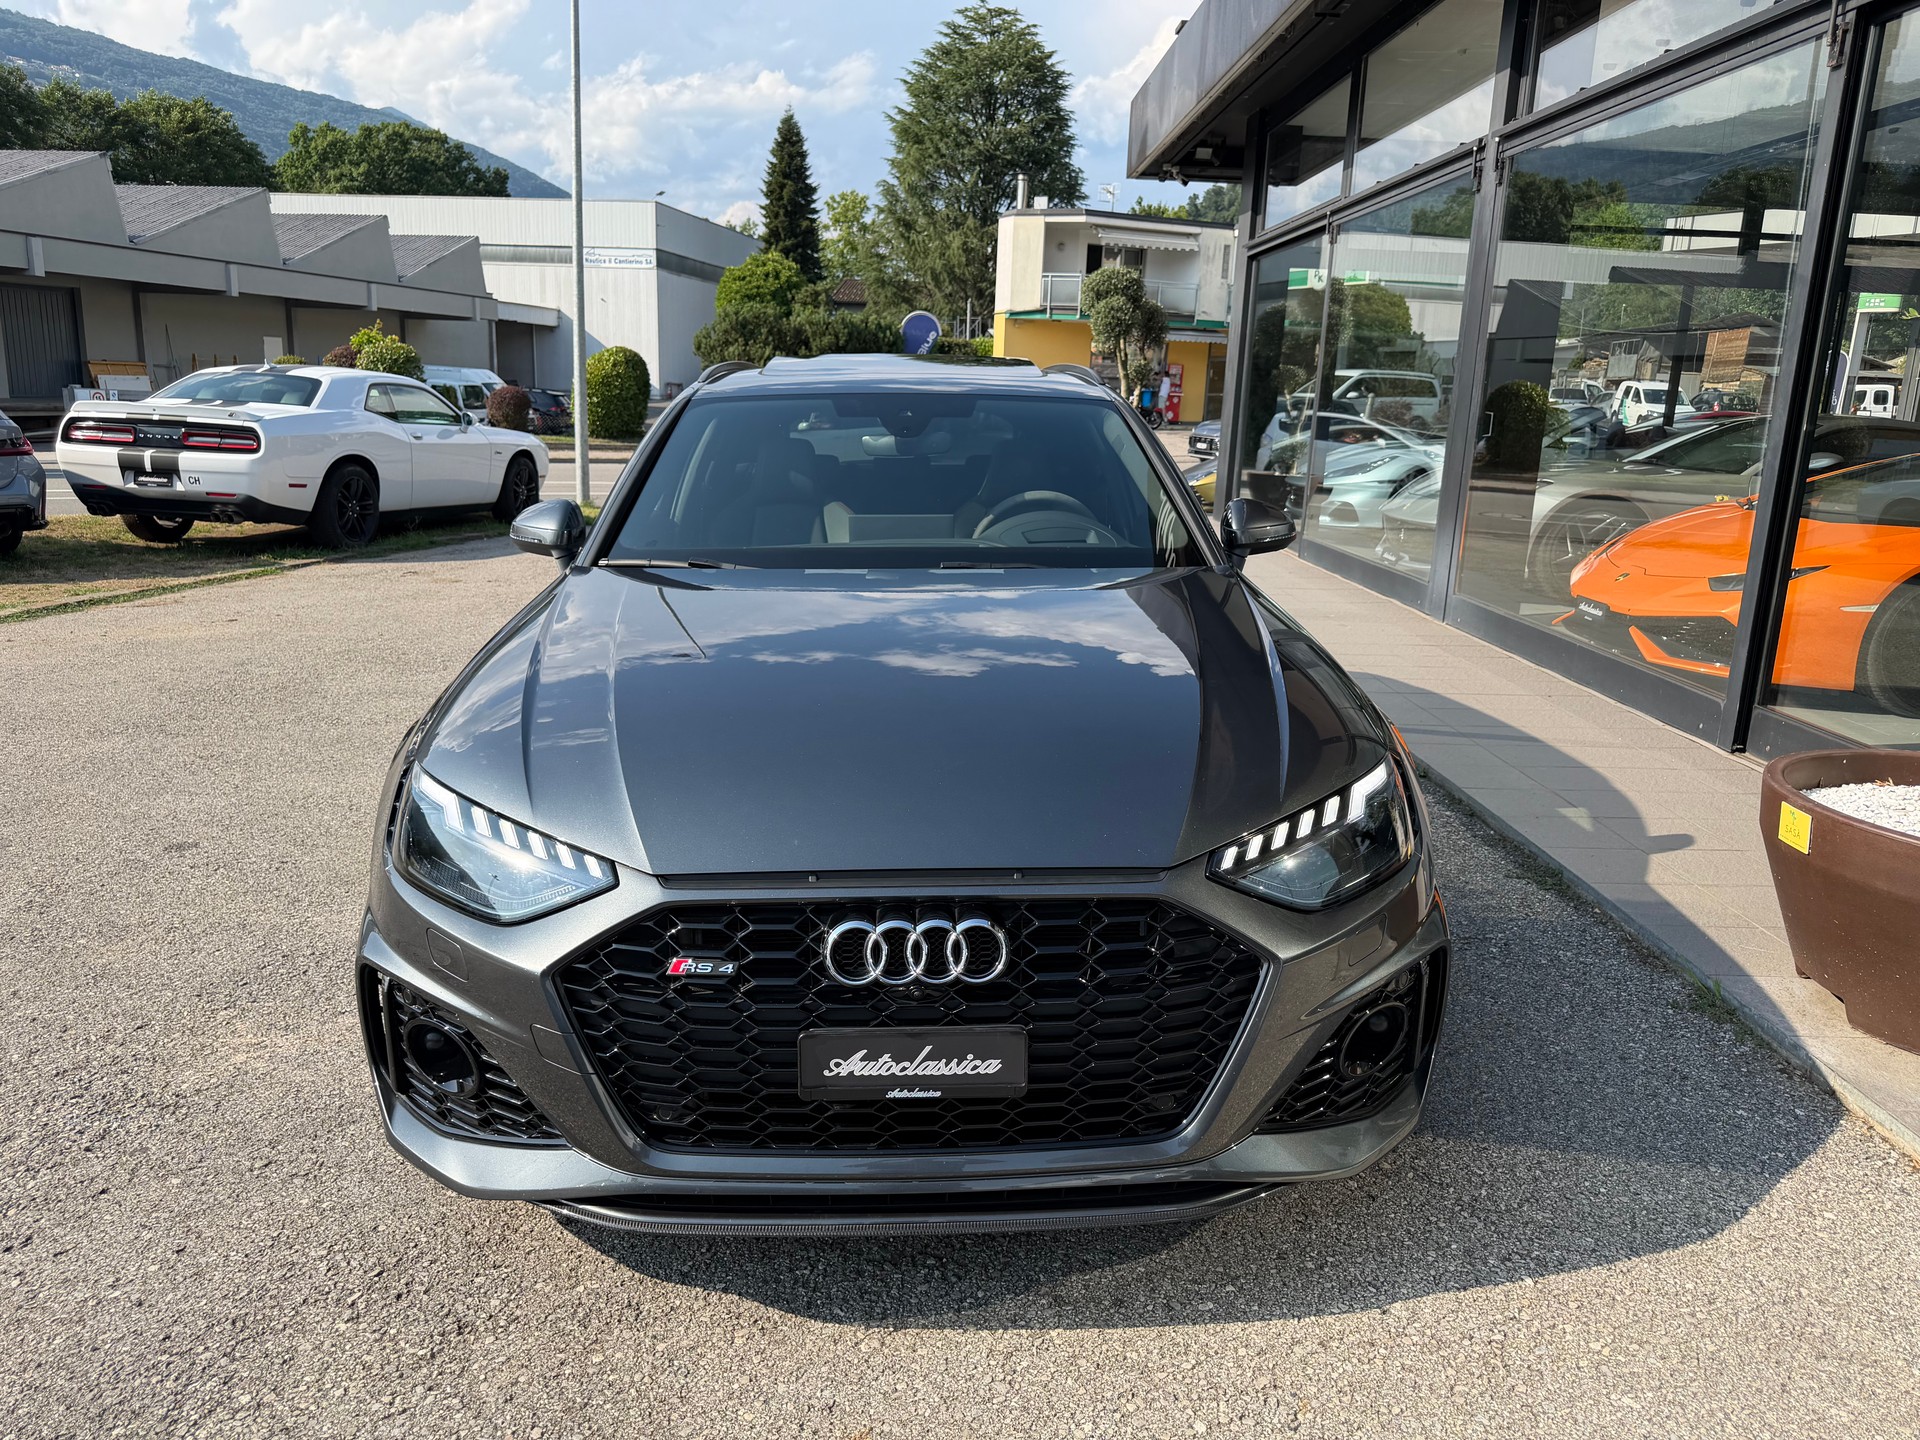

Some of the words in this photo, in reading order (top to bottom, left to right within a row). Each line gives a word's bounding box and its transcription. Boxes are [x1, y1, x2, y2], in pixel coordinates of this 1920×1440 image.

[187, 475, 201, 486] CH
[679, 961, 714, 974] RS
[718, 963, 735, 974] 4
[822, 1045, 1003, 1077] Autoclassica
[885, 1087, 943, 1099] Autoclassica
